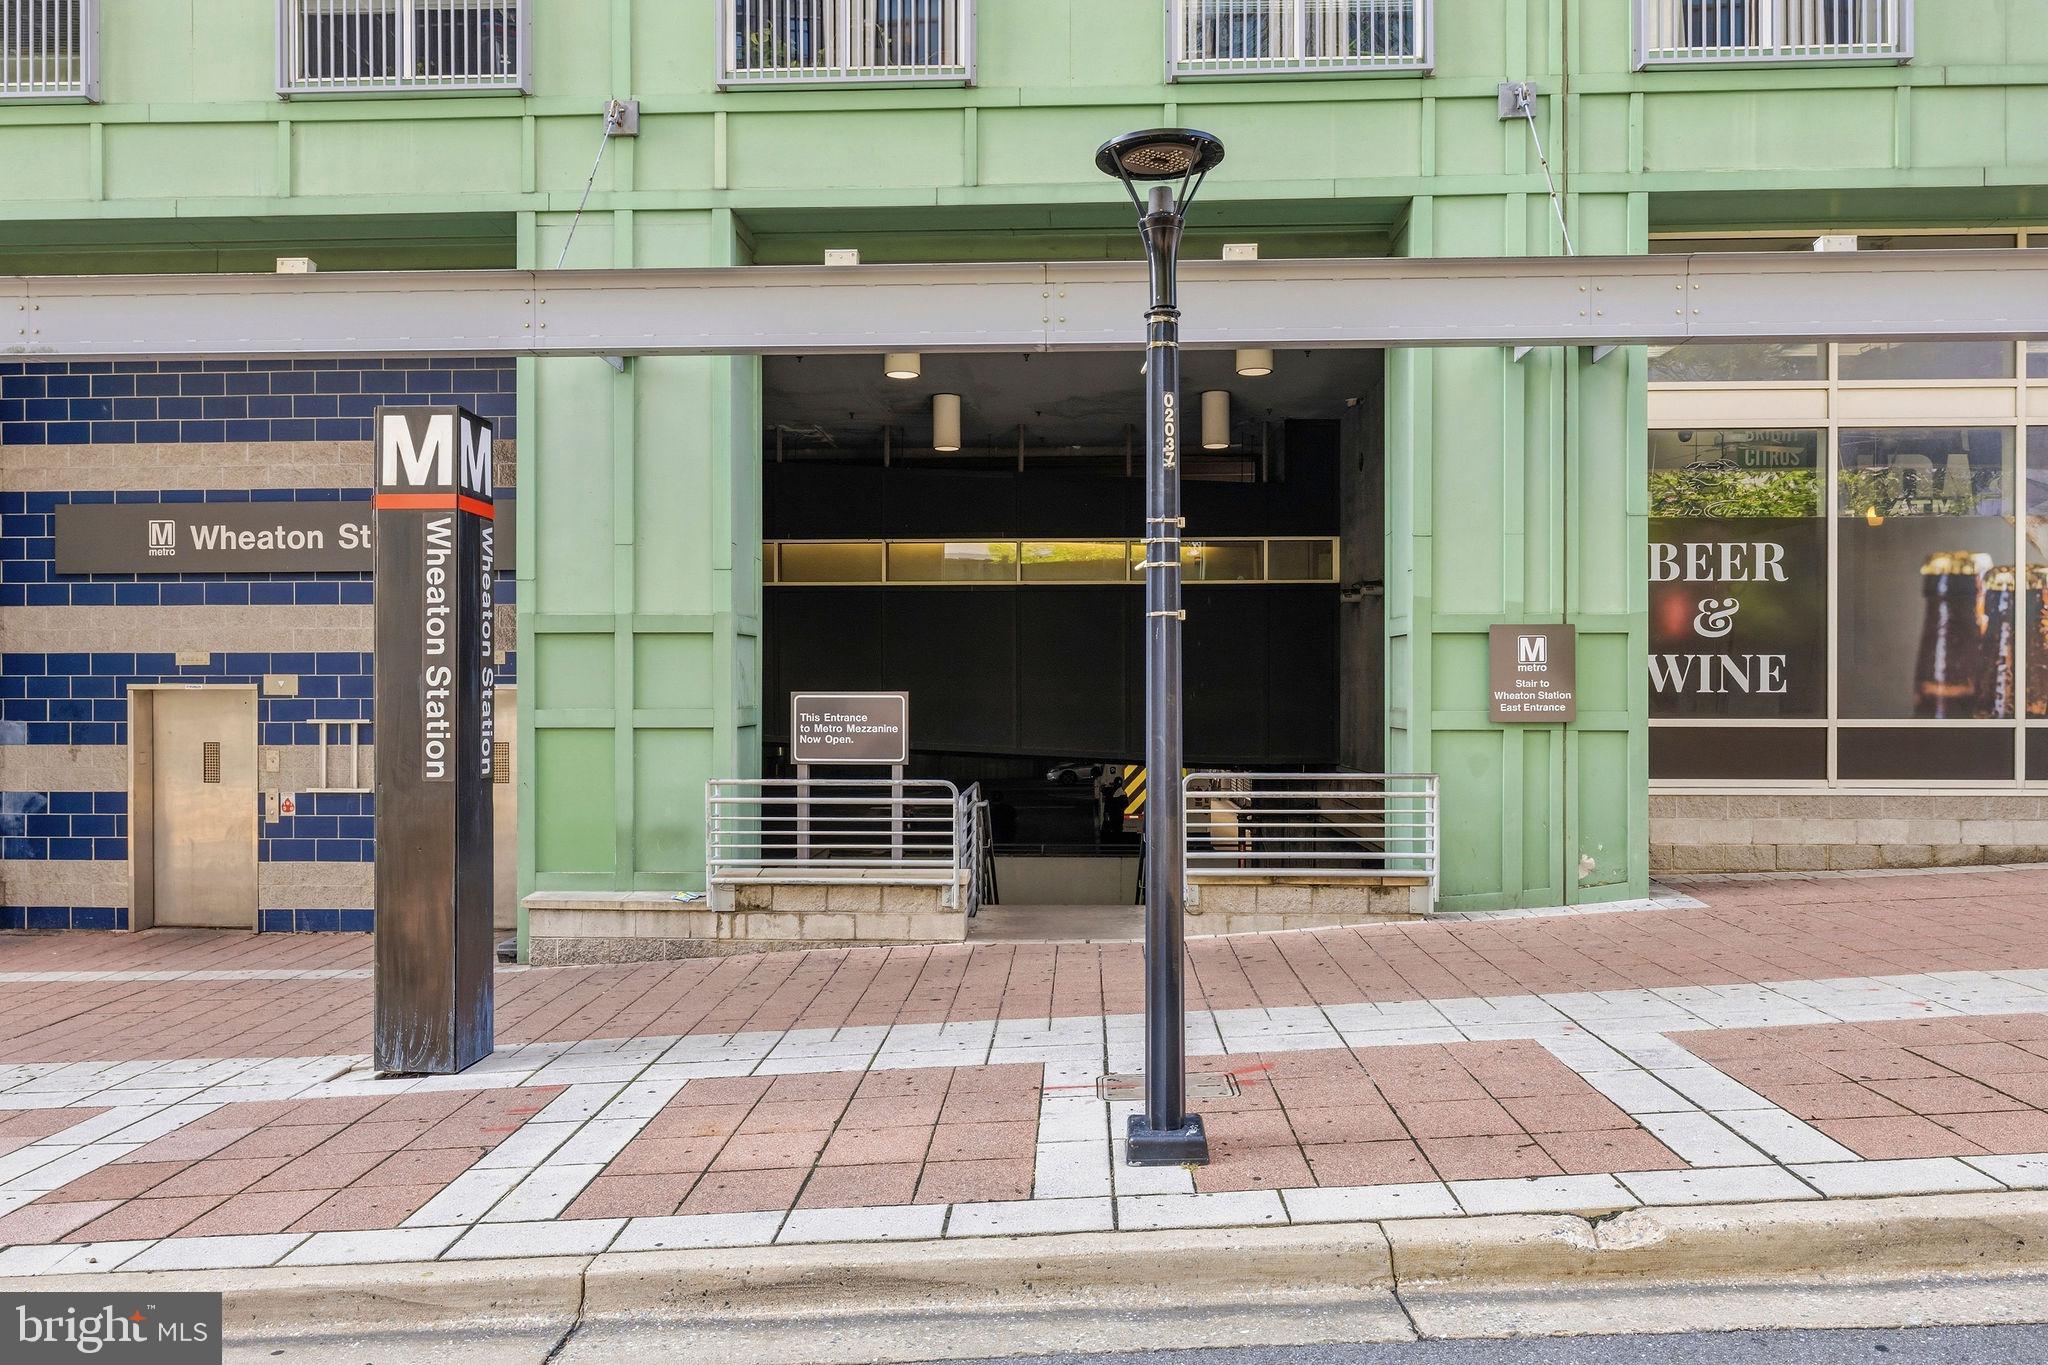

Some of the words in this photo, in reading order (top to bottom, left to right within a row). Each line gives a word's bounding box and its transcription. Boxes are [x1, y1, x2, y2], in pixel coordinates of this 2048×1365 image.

[382, 414, 453, 486] M
[460, 416, 492, 498] M
[151, 522, 173, 546] M
[190, 524, 324, 550] Wheaton
[338, 522, 372, 550] St
[148, 549, 176, 557] metro
[1648, 542, 1789, 582] BEER
[426, 517, 452, 655] Wheaton
[481, 526, 494, 658] Wheaton
[1693, 597, 1740, 638] &
[1519, 636, 1546, 662] M
[1517, 663, 1548, 672] metro
[1648, 654, 1787, 694] WINE
[1494, 691, 1536, 700] Wheaton
[1537, 691, 1572, 700] Station
[1515, 679, 1538, 688] Stair
[1540, 679, 1550, 688] to
[481, 666, 494, 775] Station
[799, 713, 821, 722] This
[824, 713, 868, 722] Entrance
[1500, 703, 1522, 712] East
[1523, 703, 1567, 712] Entrance
[426, 665, 452, 778] Station
[799, 724, 811, 733] to
[814, 724, 843, 733] Metro
[846, 724, 899, 733] Mezzanine
[799, 734, 821, 744] Now
[825, 734, 854, 745] Open.
